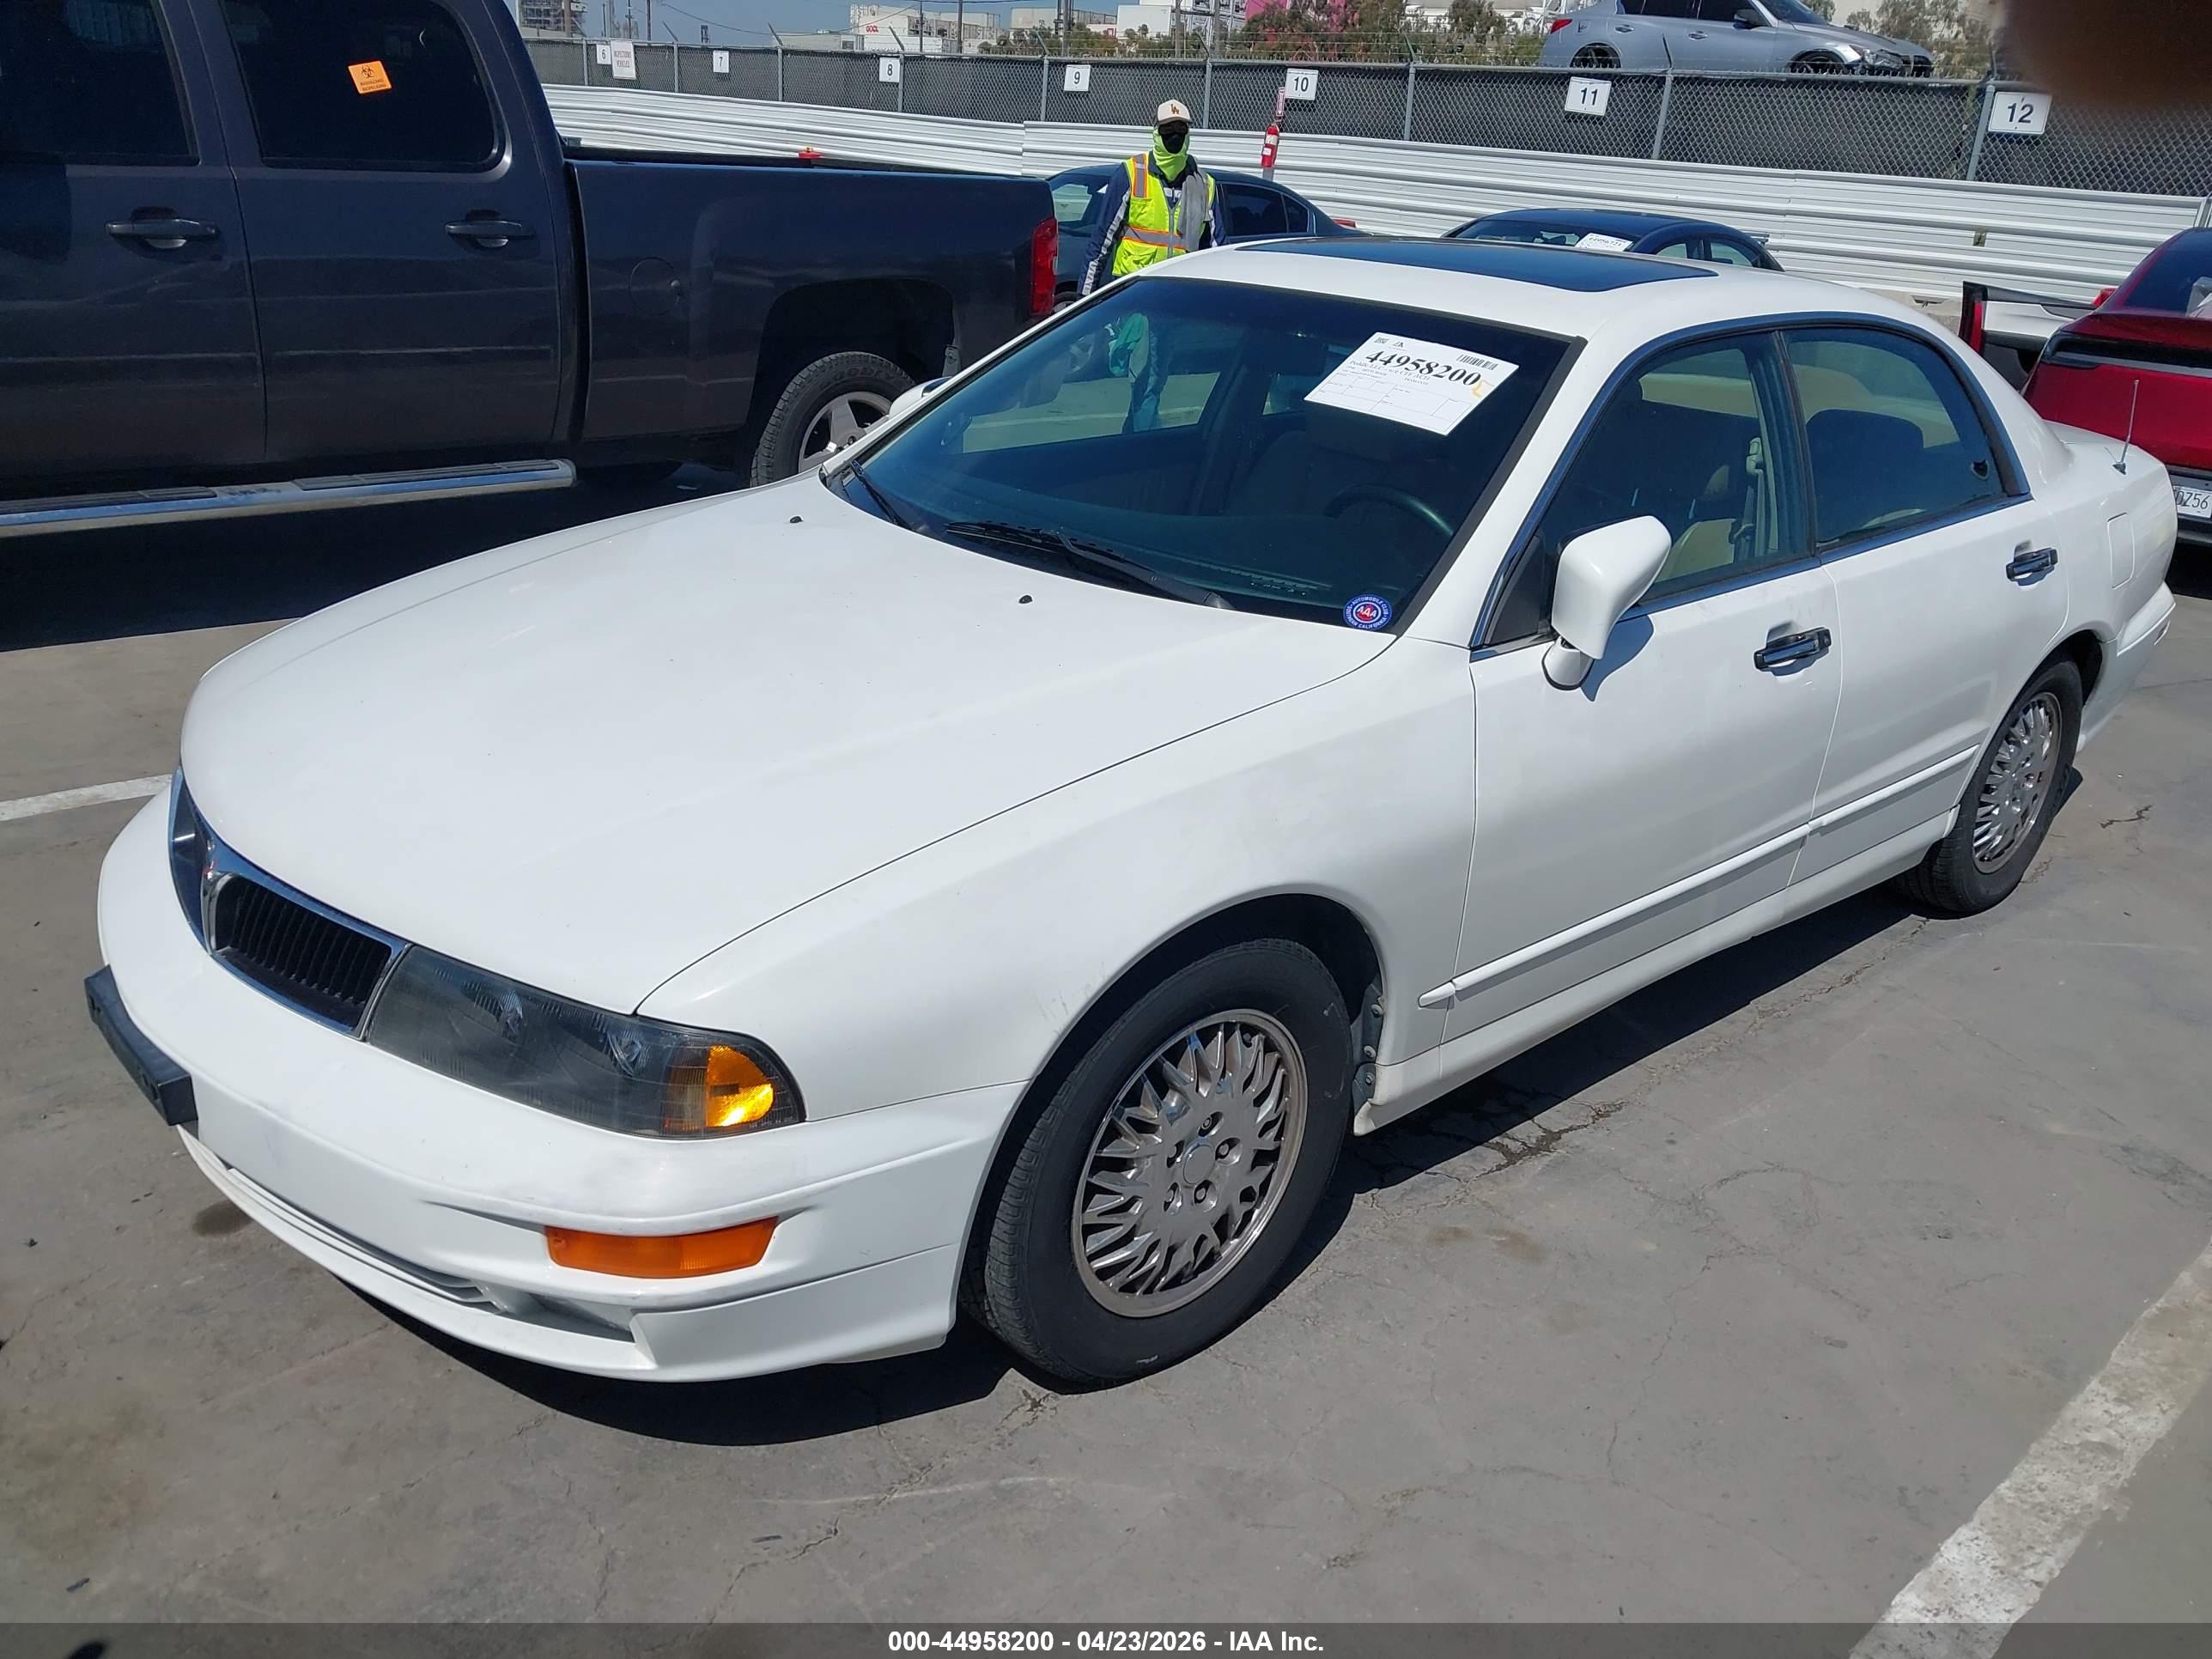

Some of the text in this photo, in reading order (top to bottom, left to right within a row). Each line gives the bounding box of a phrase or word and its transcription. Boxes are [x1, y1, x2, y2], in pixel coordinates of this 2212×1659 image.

[601, 48, 606, 60] 6
[887, 64, 893, 76] 8
[1073, 71, 1080, 84] 9
[1293, 76, 1309, 92] 10
[1581, 88, 1598, 106] 11
[1170, 103, 1180, 115] LA
[2008, 102, 2034, 124] 12
[1365, 350, 1481, 386] 44958200
[1352, 596, 1384, 605] AUTOMOBILE
[1357, 605, 1377, 617] AAA
